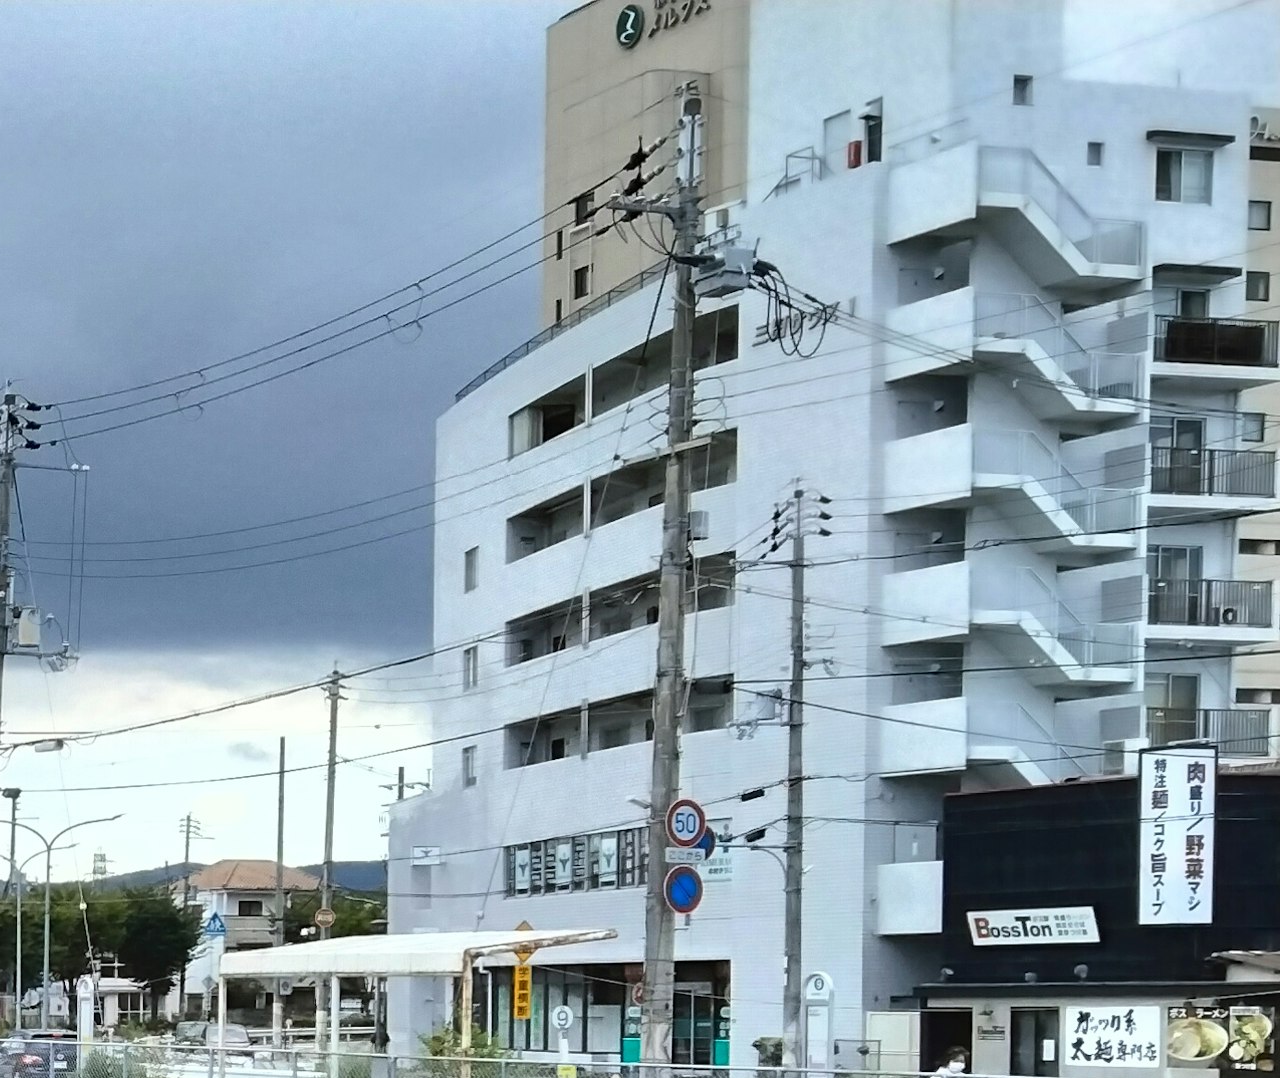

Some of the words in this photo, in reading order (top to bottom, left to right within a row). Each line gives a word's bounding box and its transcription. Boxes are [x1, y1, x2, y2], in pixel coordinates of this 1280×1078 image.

[675, 812, 696, 833] 50
[557, 1010, 569, 1027] 9
[1196, 1008, 1228, 1018] ラーメン
